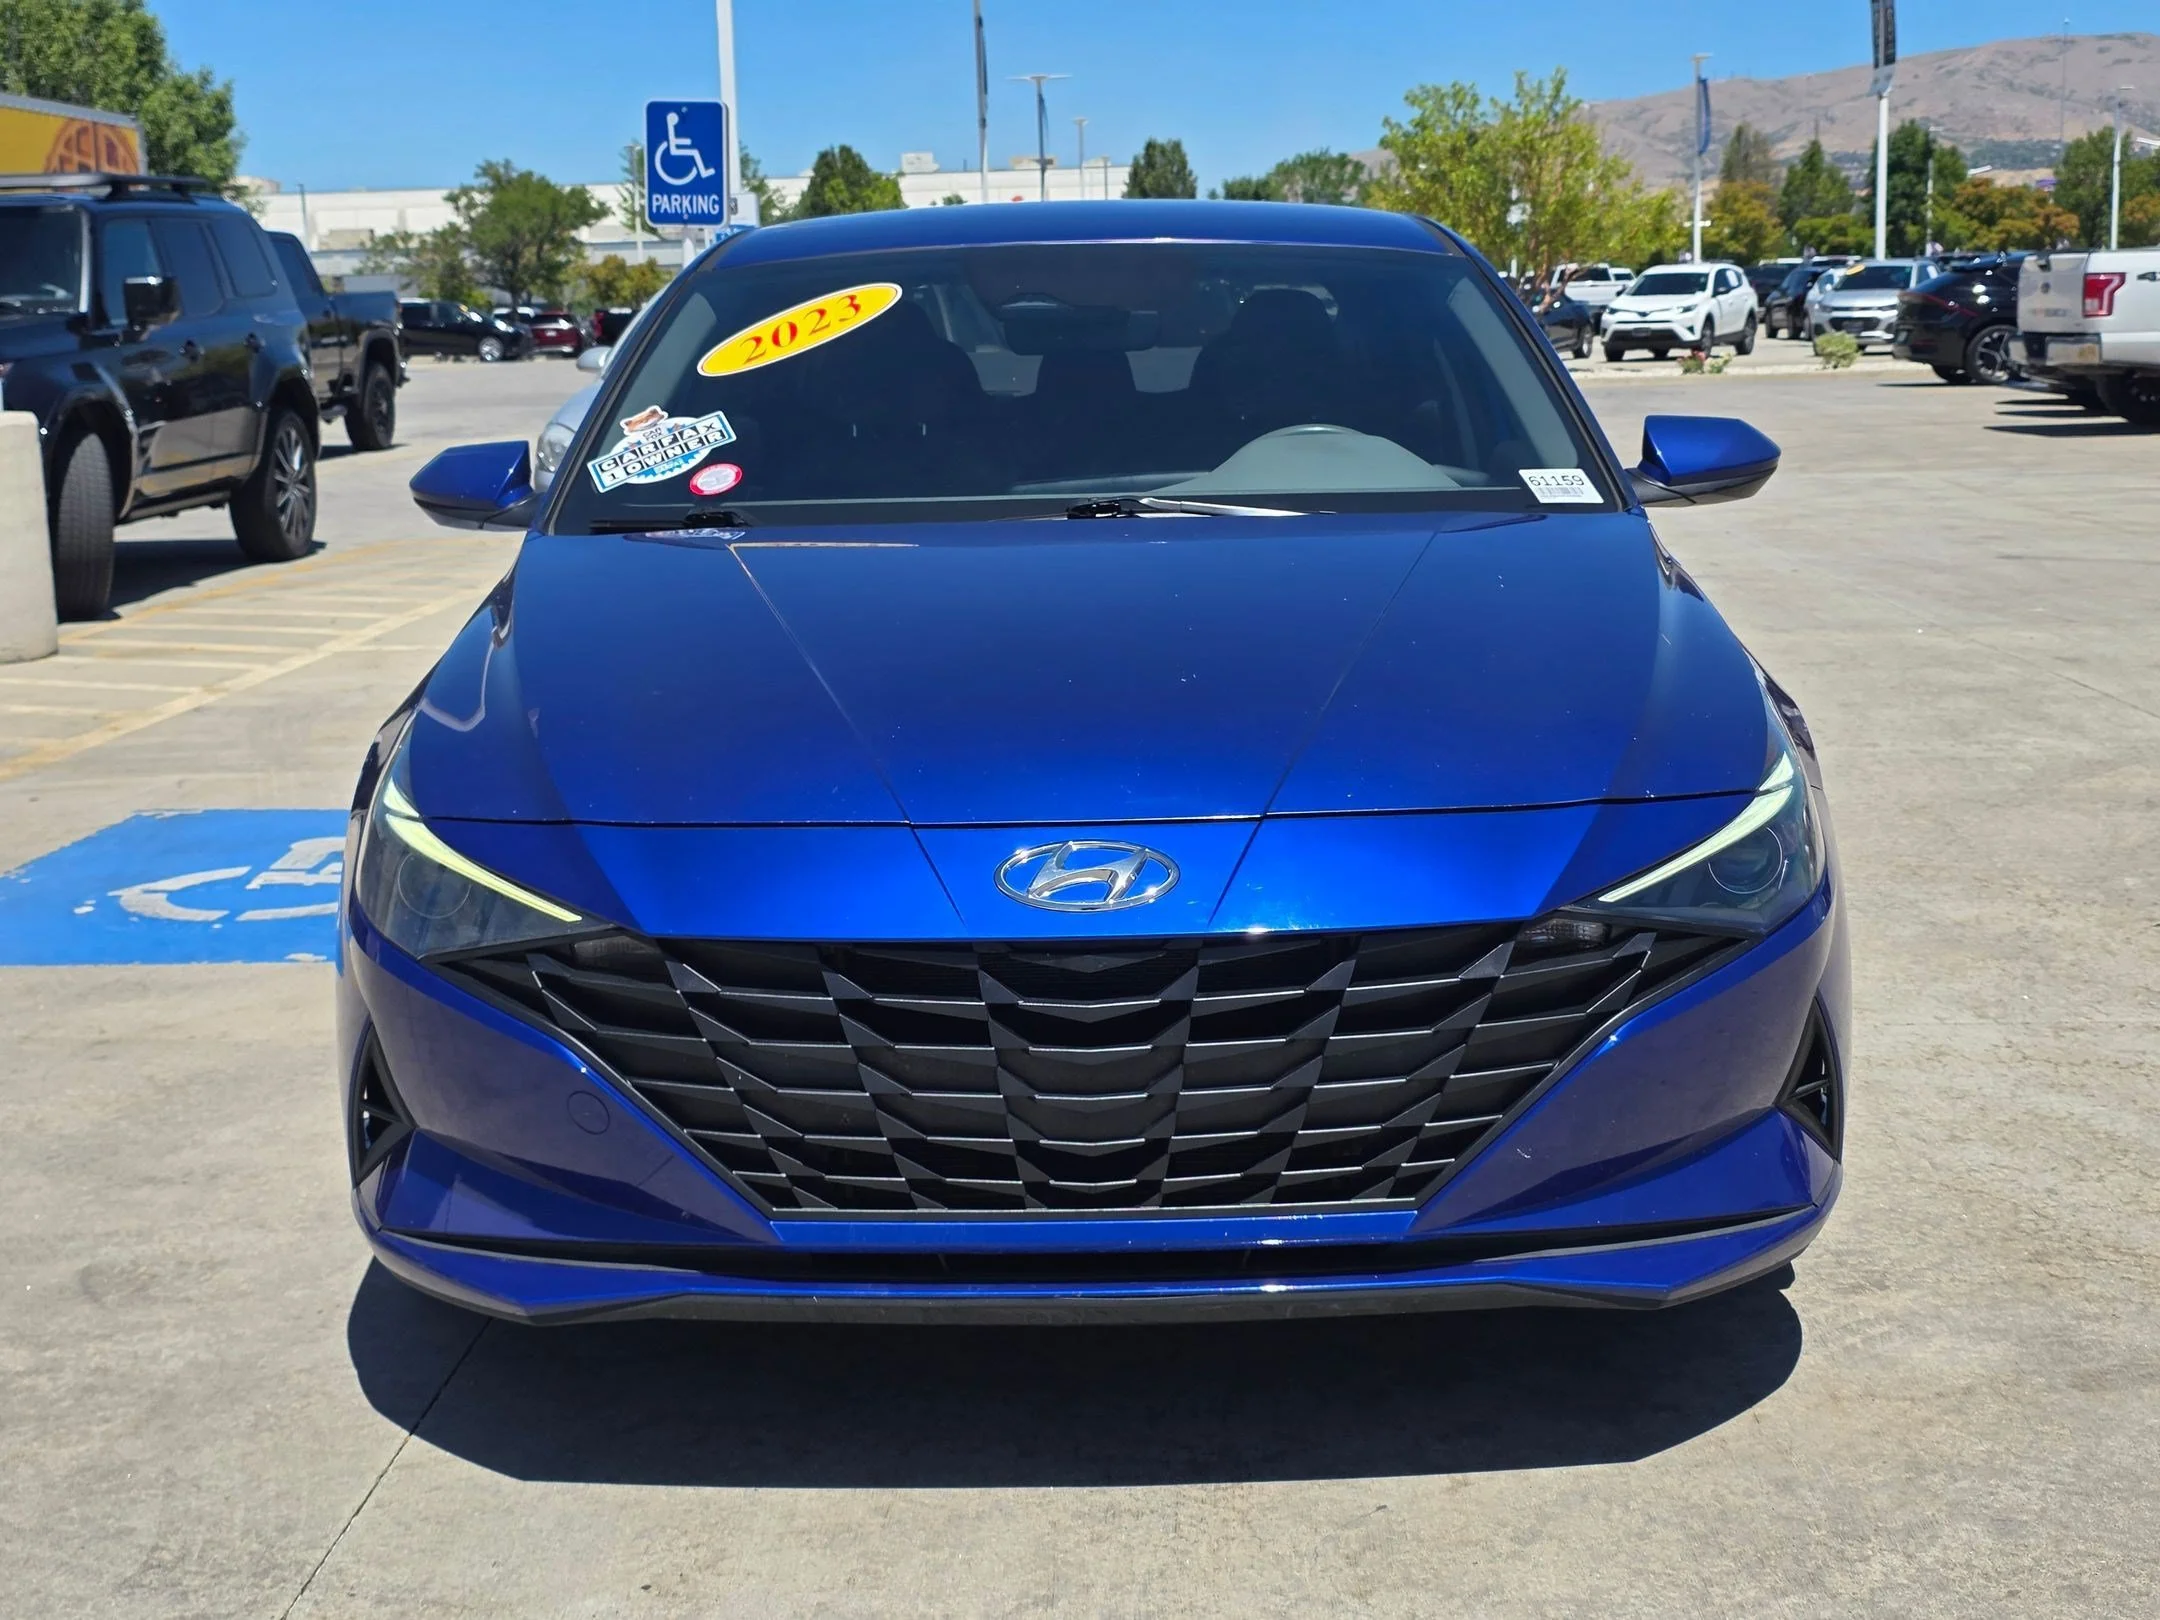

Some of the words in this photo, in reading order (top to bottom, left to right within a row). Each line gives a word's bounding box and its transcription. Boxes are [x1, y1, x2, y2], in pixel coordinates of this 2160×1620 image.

[652, 194, 720, 216] PARKING
[739, 294, 862, 365] 2023
[600, 422, 716, 472] CARFAX
[607, 472, 619, 482] 1
[625, 431, 724, 475] OWNER
[1528, 475, 1585, 486] 61159
